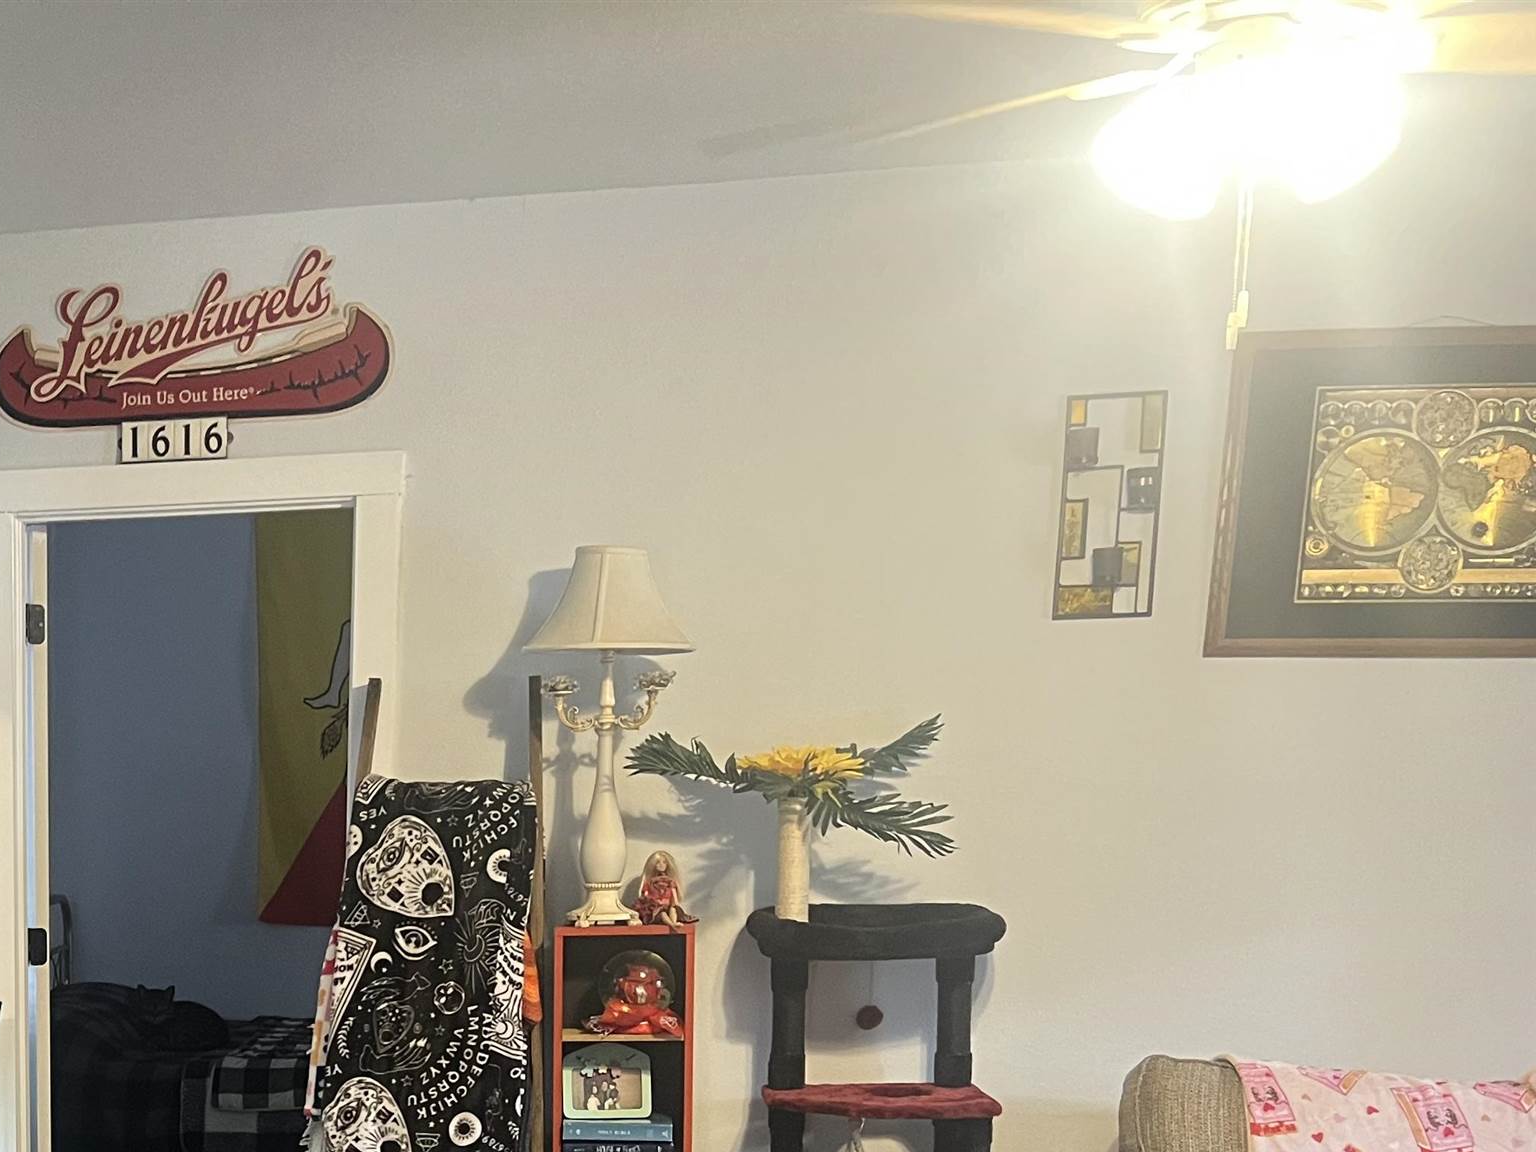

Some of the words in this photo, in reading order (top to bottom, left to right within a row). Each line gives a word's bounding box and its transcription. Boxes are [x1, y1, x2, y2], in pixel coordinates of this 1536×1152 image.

[31, 247, 334, 401] Leinenkugel's
[121, 390, 152, 409] Join
[157, 389, 175, 406] Us
[179, 388, 208, 404] Out
[128, 421, 223, 458] 1616
[359, 805, 387, 822] YES
